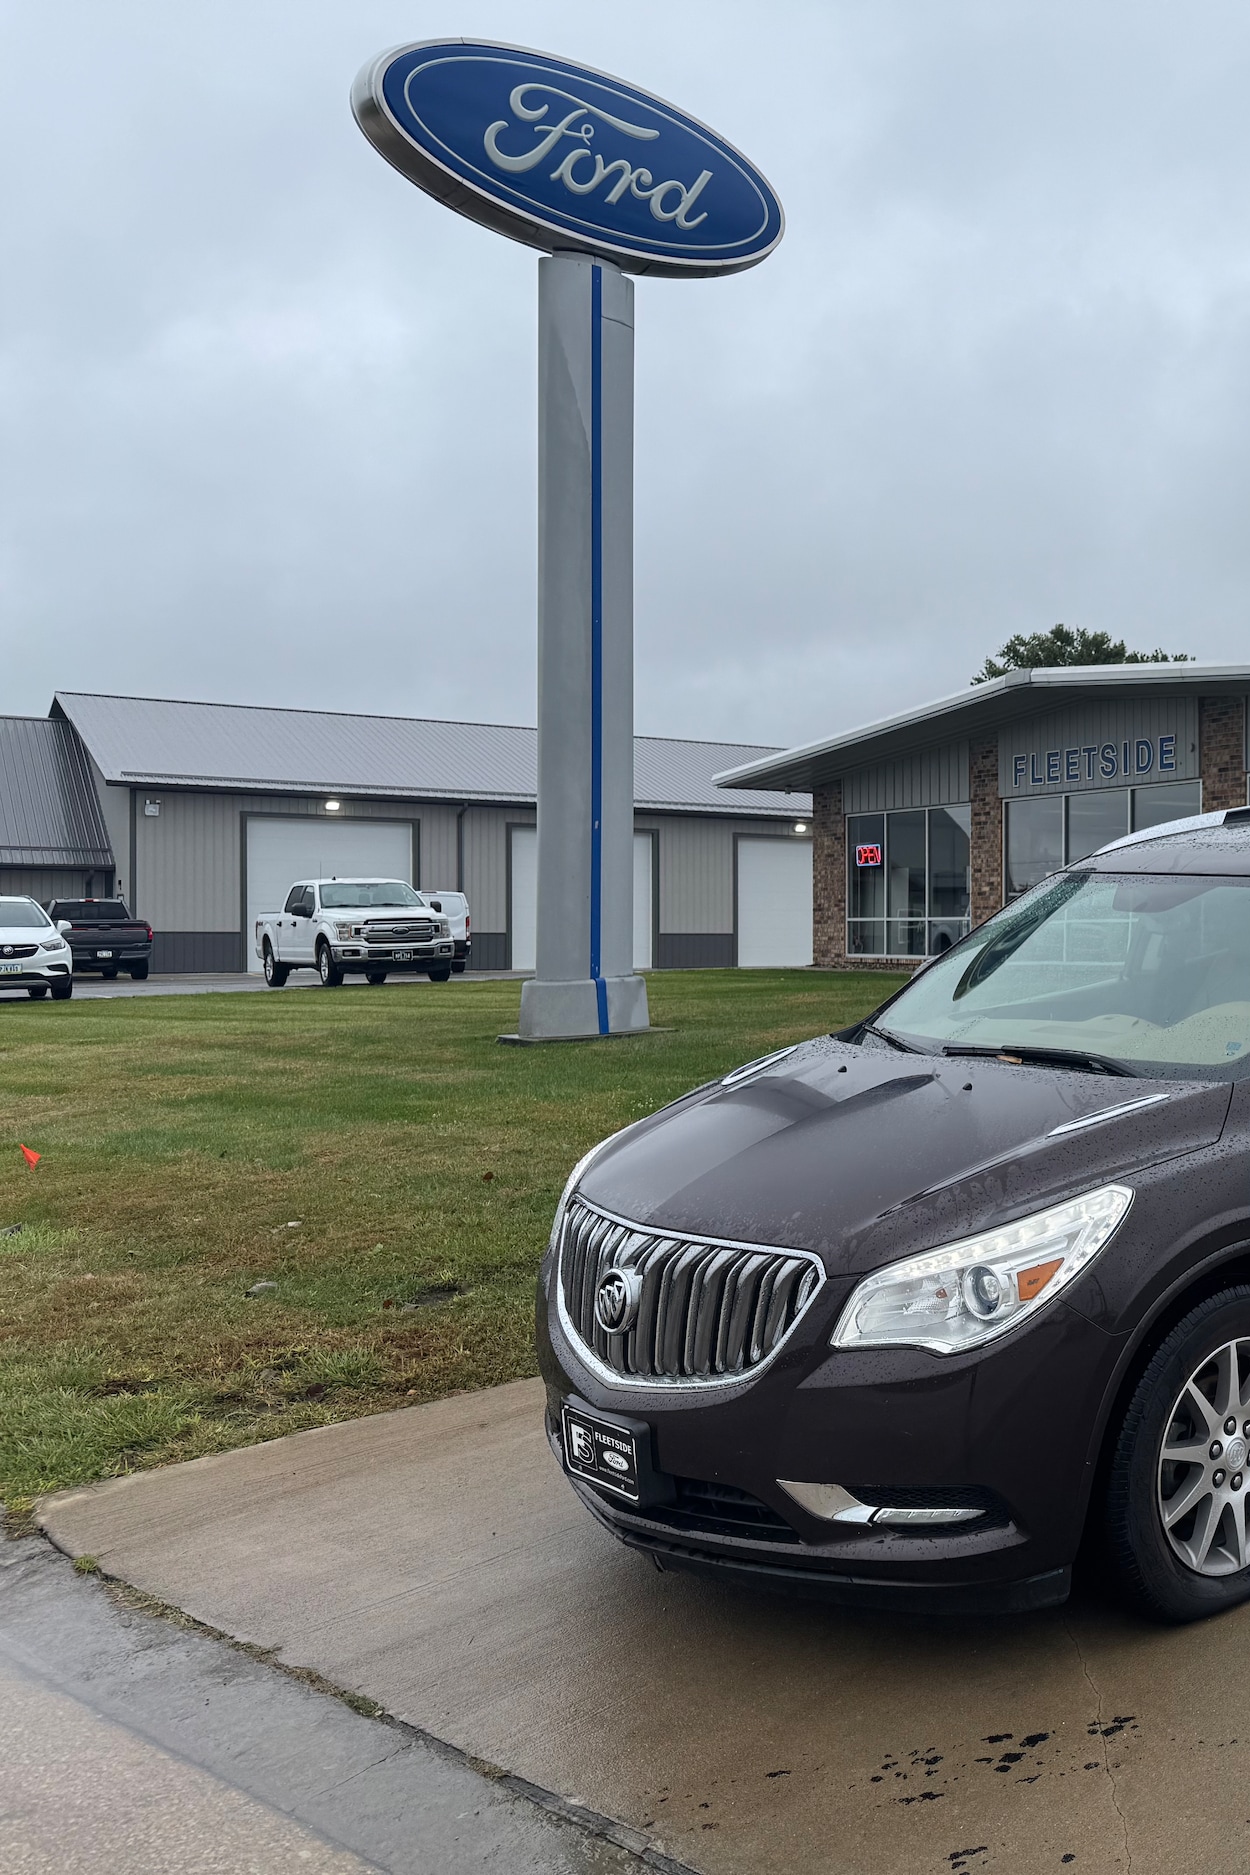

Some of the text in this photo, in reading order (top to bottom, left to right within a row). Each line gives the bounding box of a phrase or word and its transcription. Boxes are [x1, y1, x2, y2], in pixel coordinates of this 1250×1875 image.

[483, 82, 714, 231] Ford
[1012, 734, 1176, 788] FLEETSIDE
[858, 846, 881, 864] OPEN
[595, 1431, 632, 1455] FLEETSIDE
[607, 1453, 624, 1468] Ford
